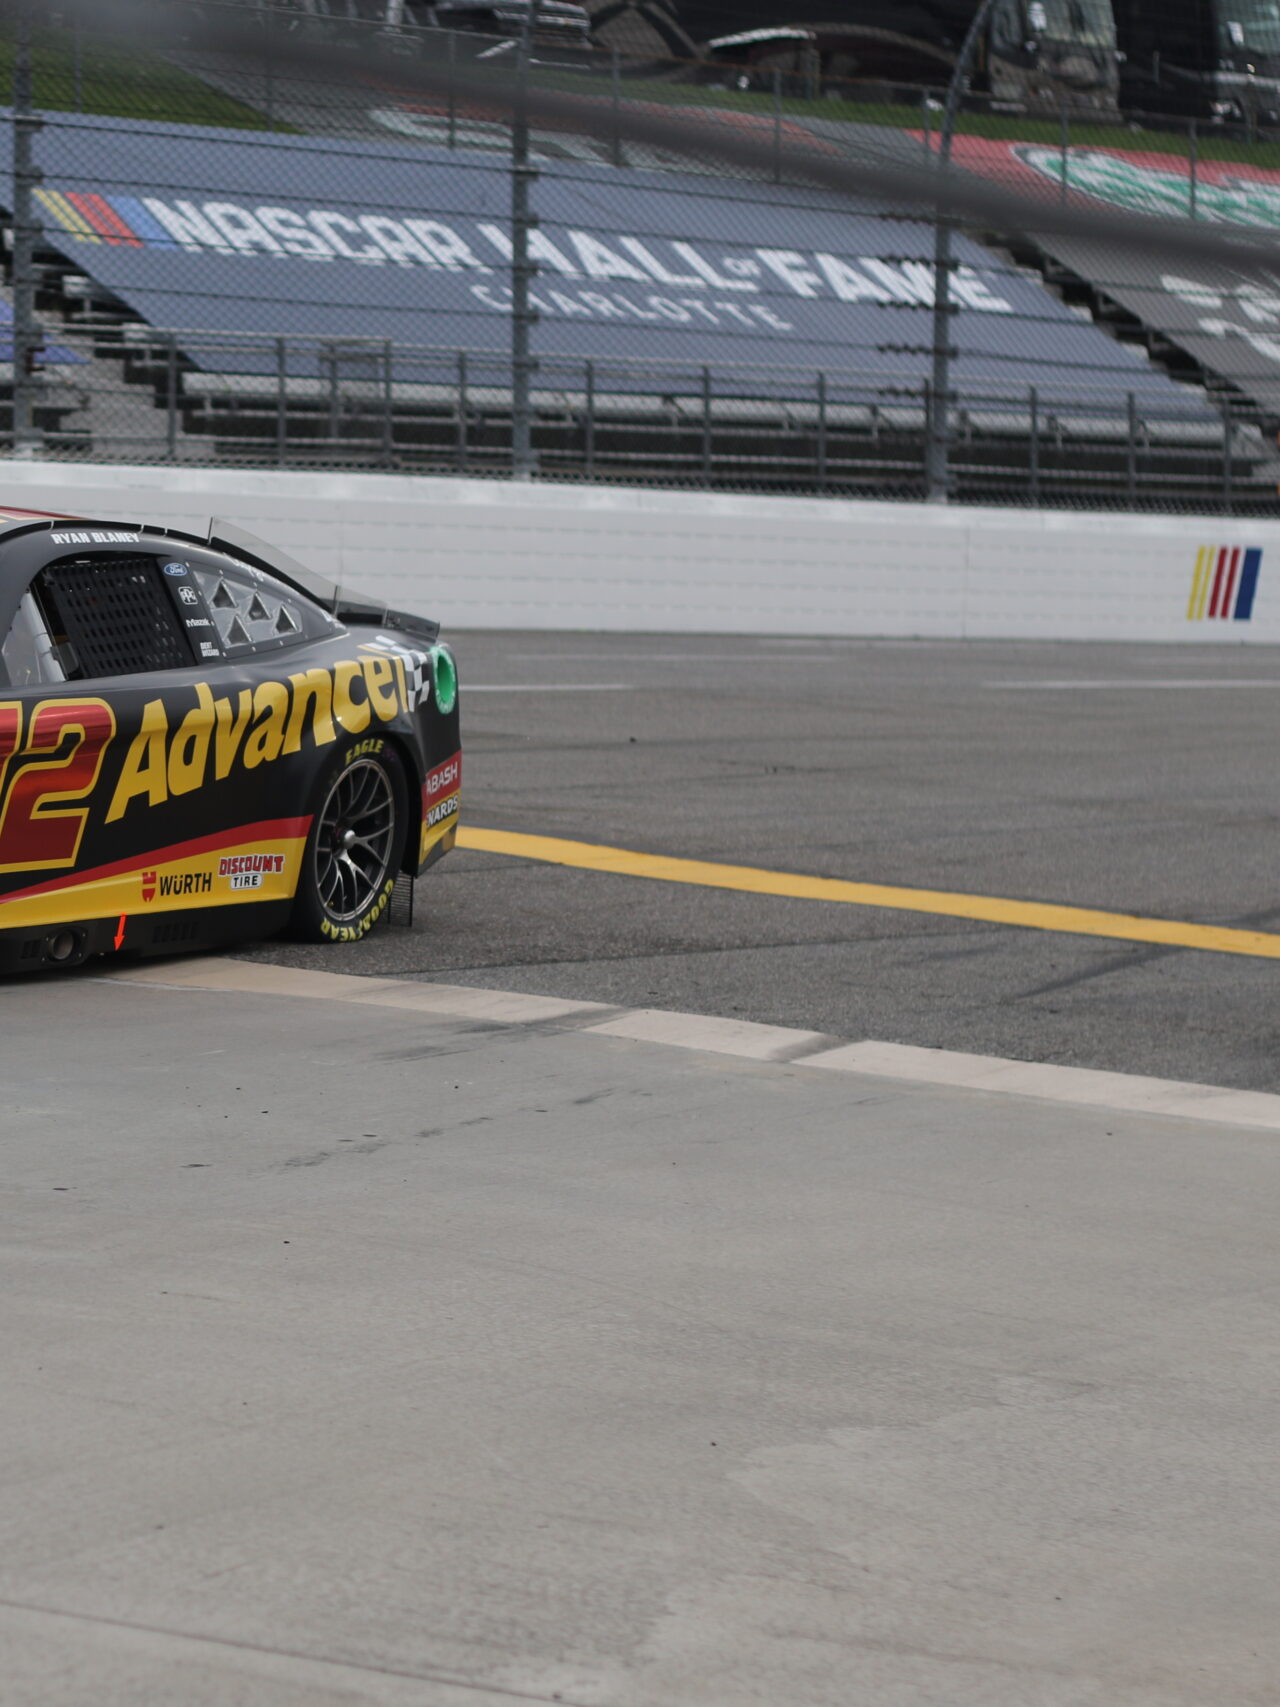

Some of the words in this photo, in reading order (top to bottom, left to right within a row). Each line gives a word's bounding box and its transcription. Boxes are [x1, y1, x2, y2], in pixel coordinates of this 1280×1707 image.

[142, 198, 494, 275] NASCAR
[477, 223, 759, 293] HALL
[757, 247, 1013, 312] FAME
[470, 285, 793, 330] CHARLOTTE
[51, 532, 91, 545] RYAN
[94, 532, 140, 544] BLANEY
[104, 655, 399, 824] Advance
[345, 738, 384, 766] EAGLE
[426, 795, 459, 828] NARDS
[218, 855, 284, 876] DISCOUNT
[233, 874, 259, 888] TIRE
